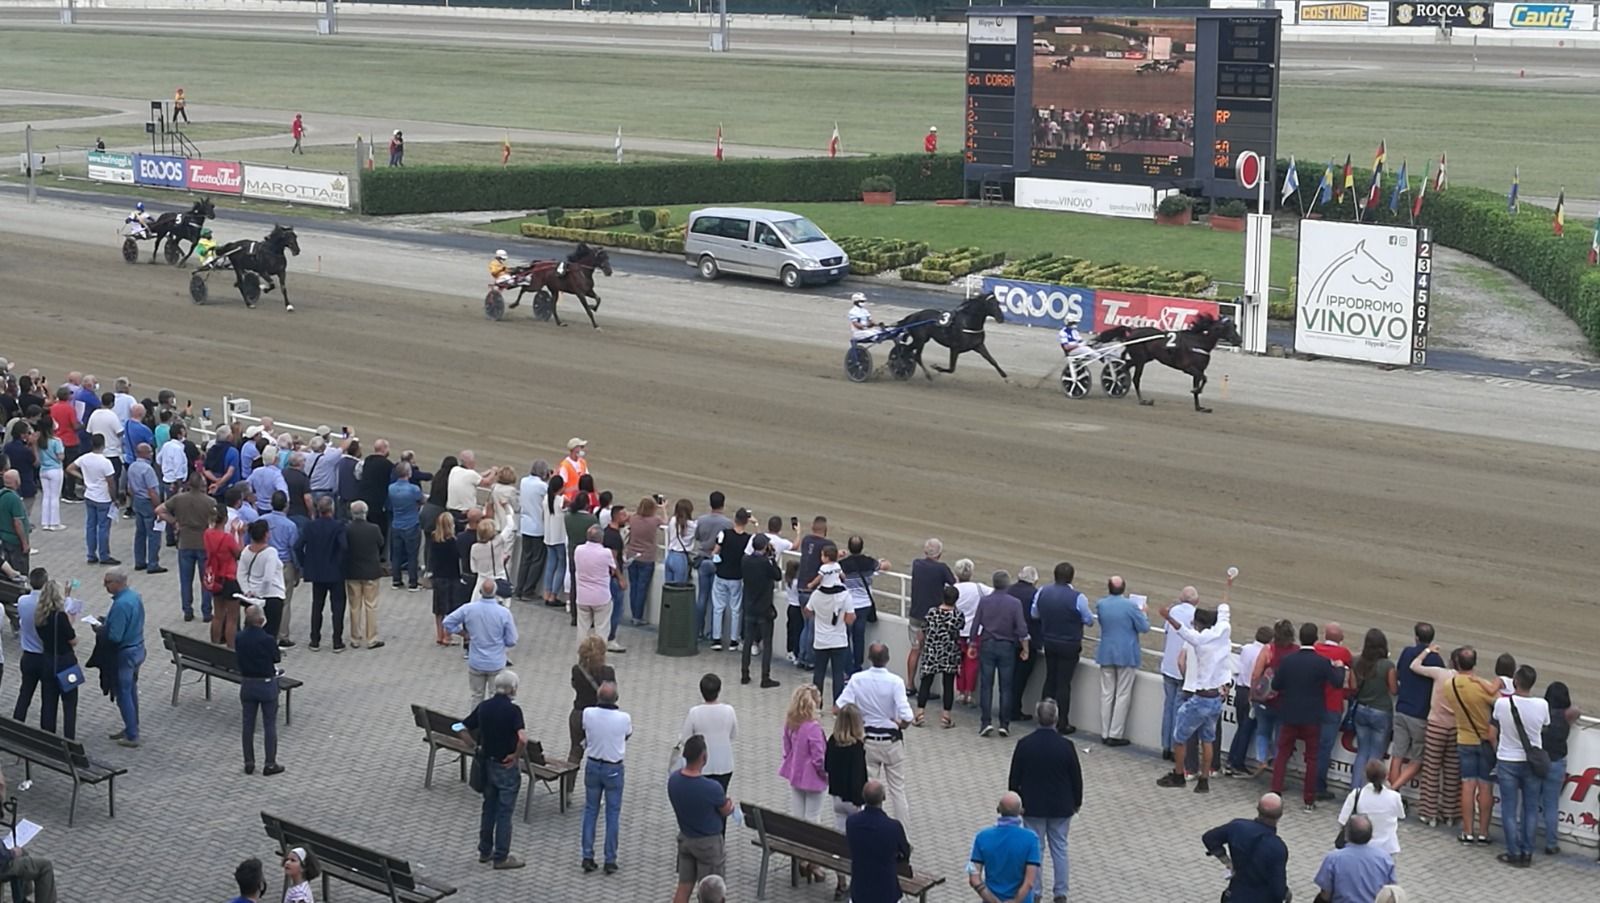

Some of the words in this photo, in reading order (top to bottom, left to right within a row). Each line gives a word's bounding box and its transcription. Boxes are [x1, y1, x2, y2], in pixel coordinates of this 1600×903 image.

[1301, 4, 1368, 20] COSTRUIRE
[1416, 4, 1465, 17] ROCCA
[1511, 5, 1573, 28] Cavit
[140, 159, 183, 181] EQUOS
[175, 213, 182, 224] 5
[1421, 228, 1428, 241] 1
[1421, 243, 1430, 256] 2
[1420, 259, 1428, 272] 3
[1418, 274, 1427, 288] 4
[994, 285, 1083, 321] EQUOS
[1418, 290, 1428, 303] 5
[1326, 295, 1404, 314] IPPODROMO
[1417, 305, 1426, 318] 6
[939, 312, 951, 325] 3
[1302, 306, 1408, 341] VINOVO
[1417, 320, 1426, 334] 7
[1166, 332, 1176, 347] 2
[1416, 335, 1424, 348] 8
[1415, 350, 1423, 364] 9
